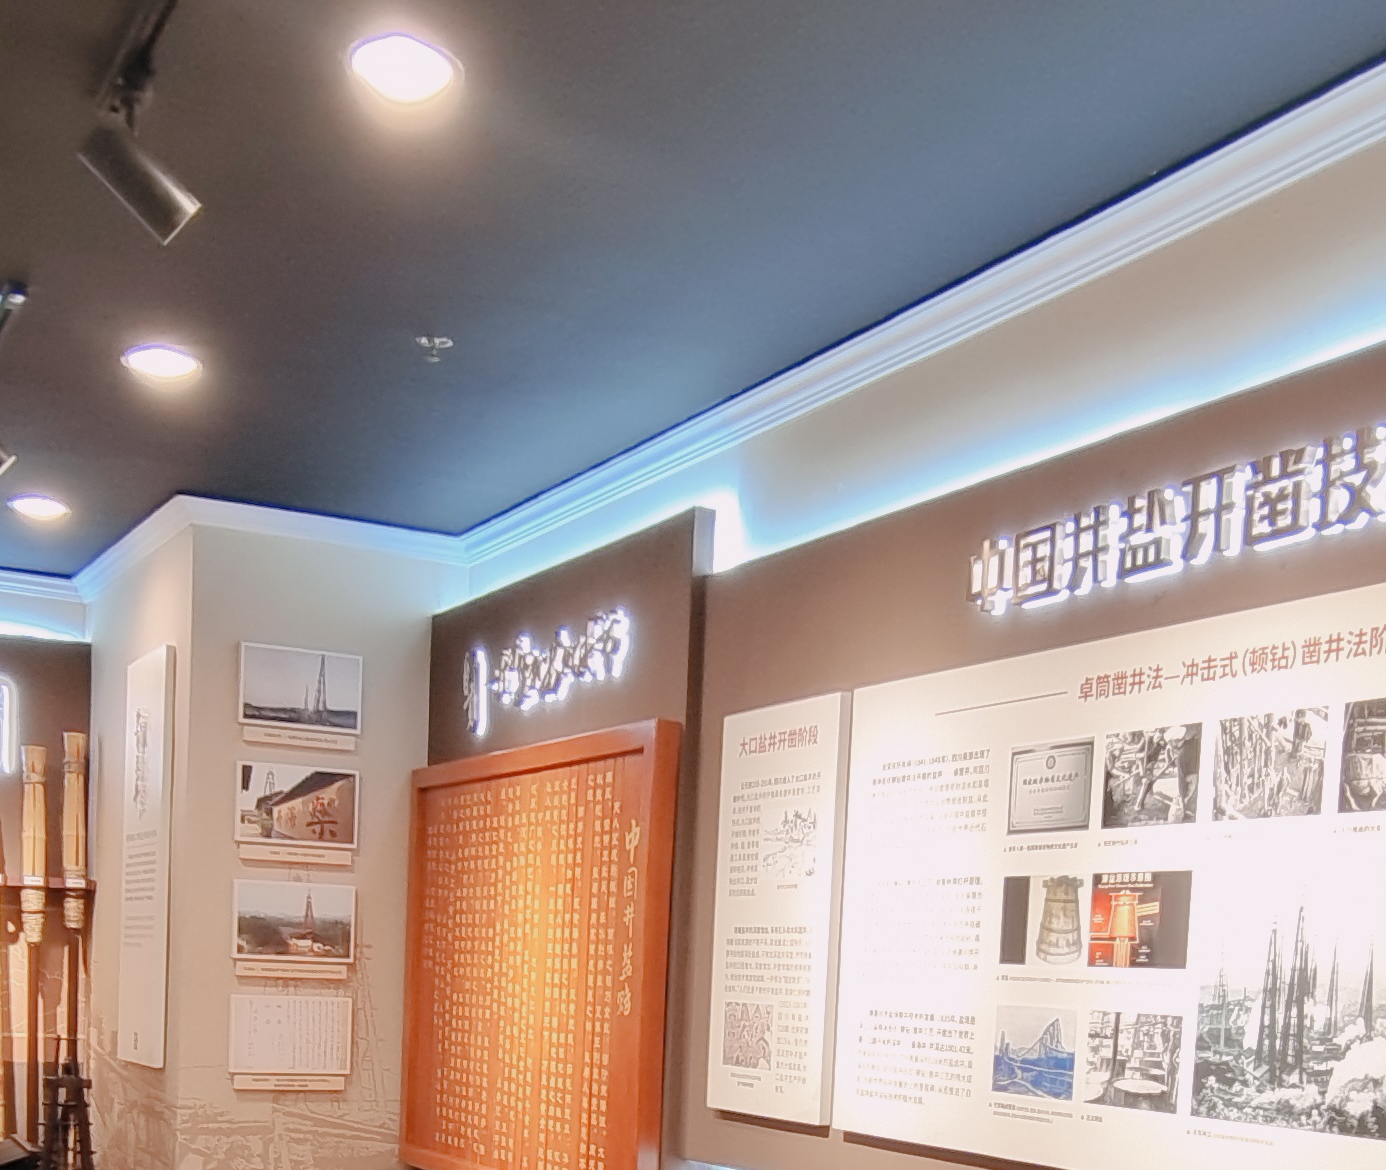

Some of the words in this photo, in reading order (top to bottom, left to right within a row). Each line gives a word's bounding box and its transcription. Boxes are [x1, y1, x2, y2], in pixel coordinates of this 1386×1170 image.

[737, 722, 819, 759] 大口盐井开凿阶段
